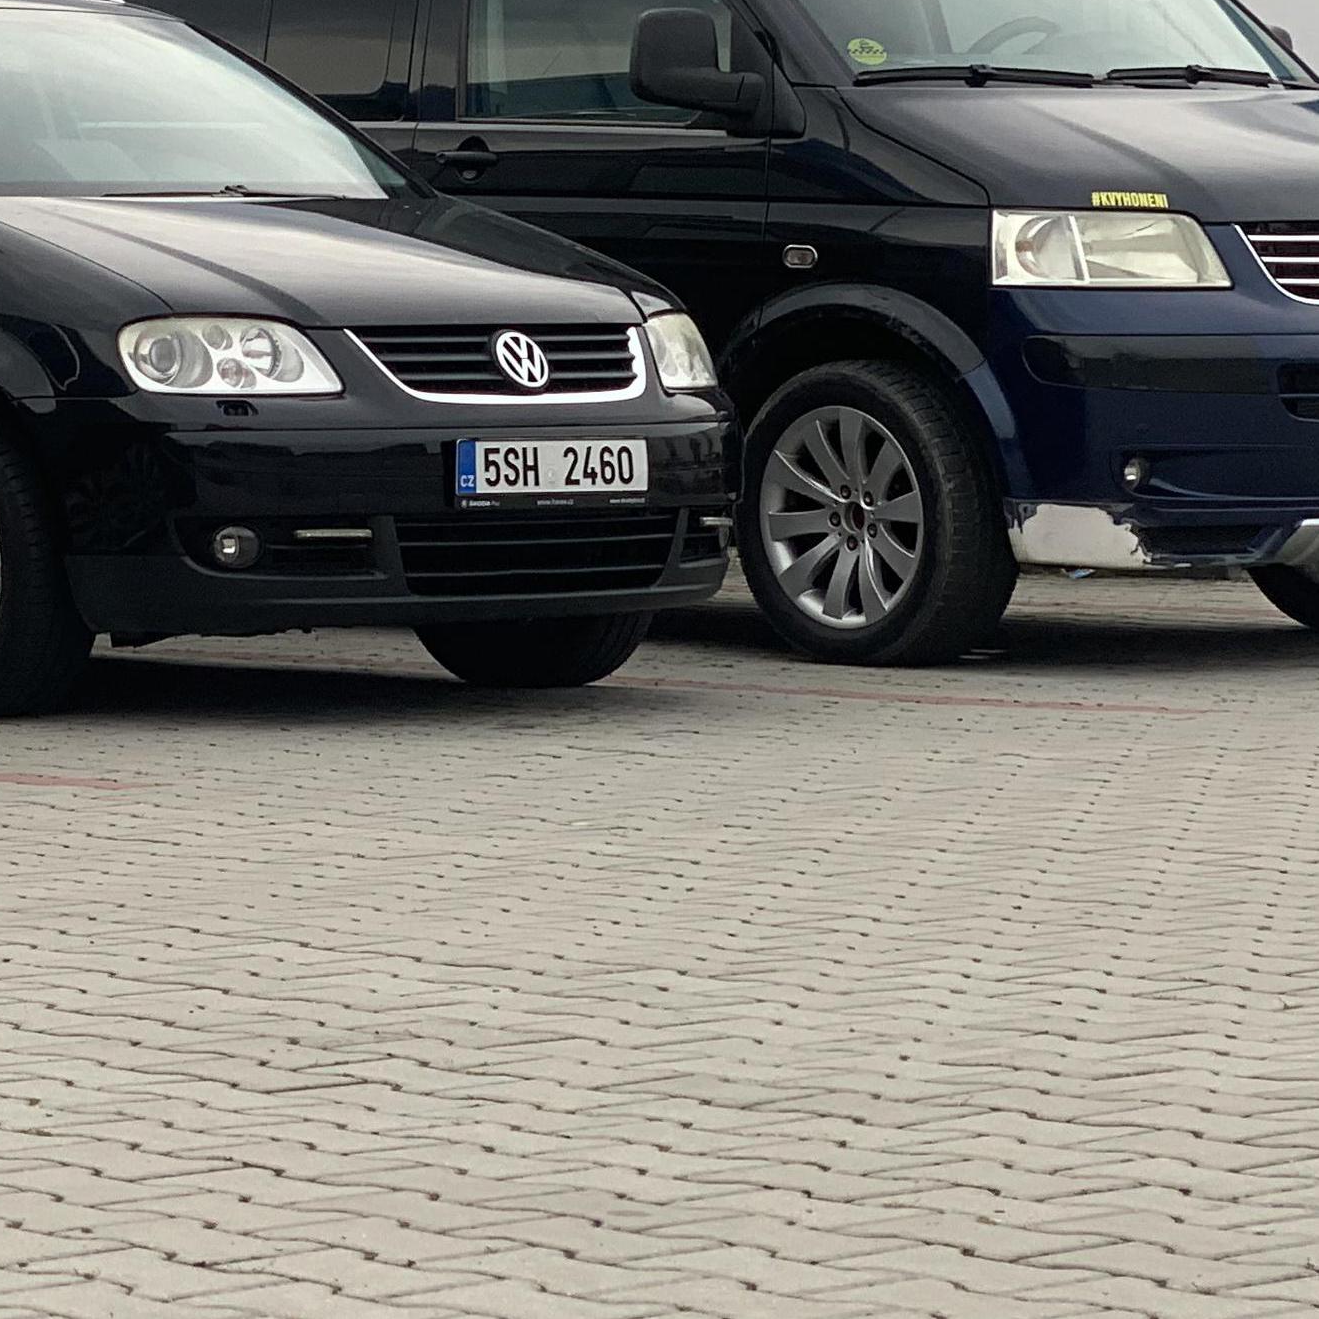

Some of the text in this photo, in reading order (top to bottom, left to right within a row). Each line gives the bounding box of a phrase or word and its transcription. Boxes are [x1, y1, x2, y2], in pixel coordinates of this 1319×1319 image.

[460, 445, 634, 487] CZ 5SH 2460
